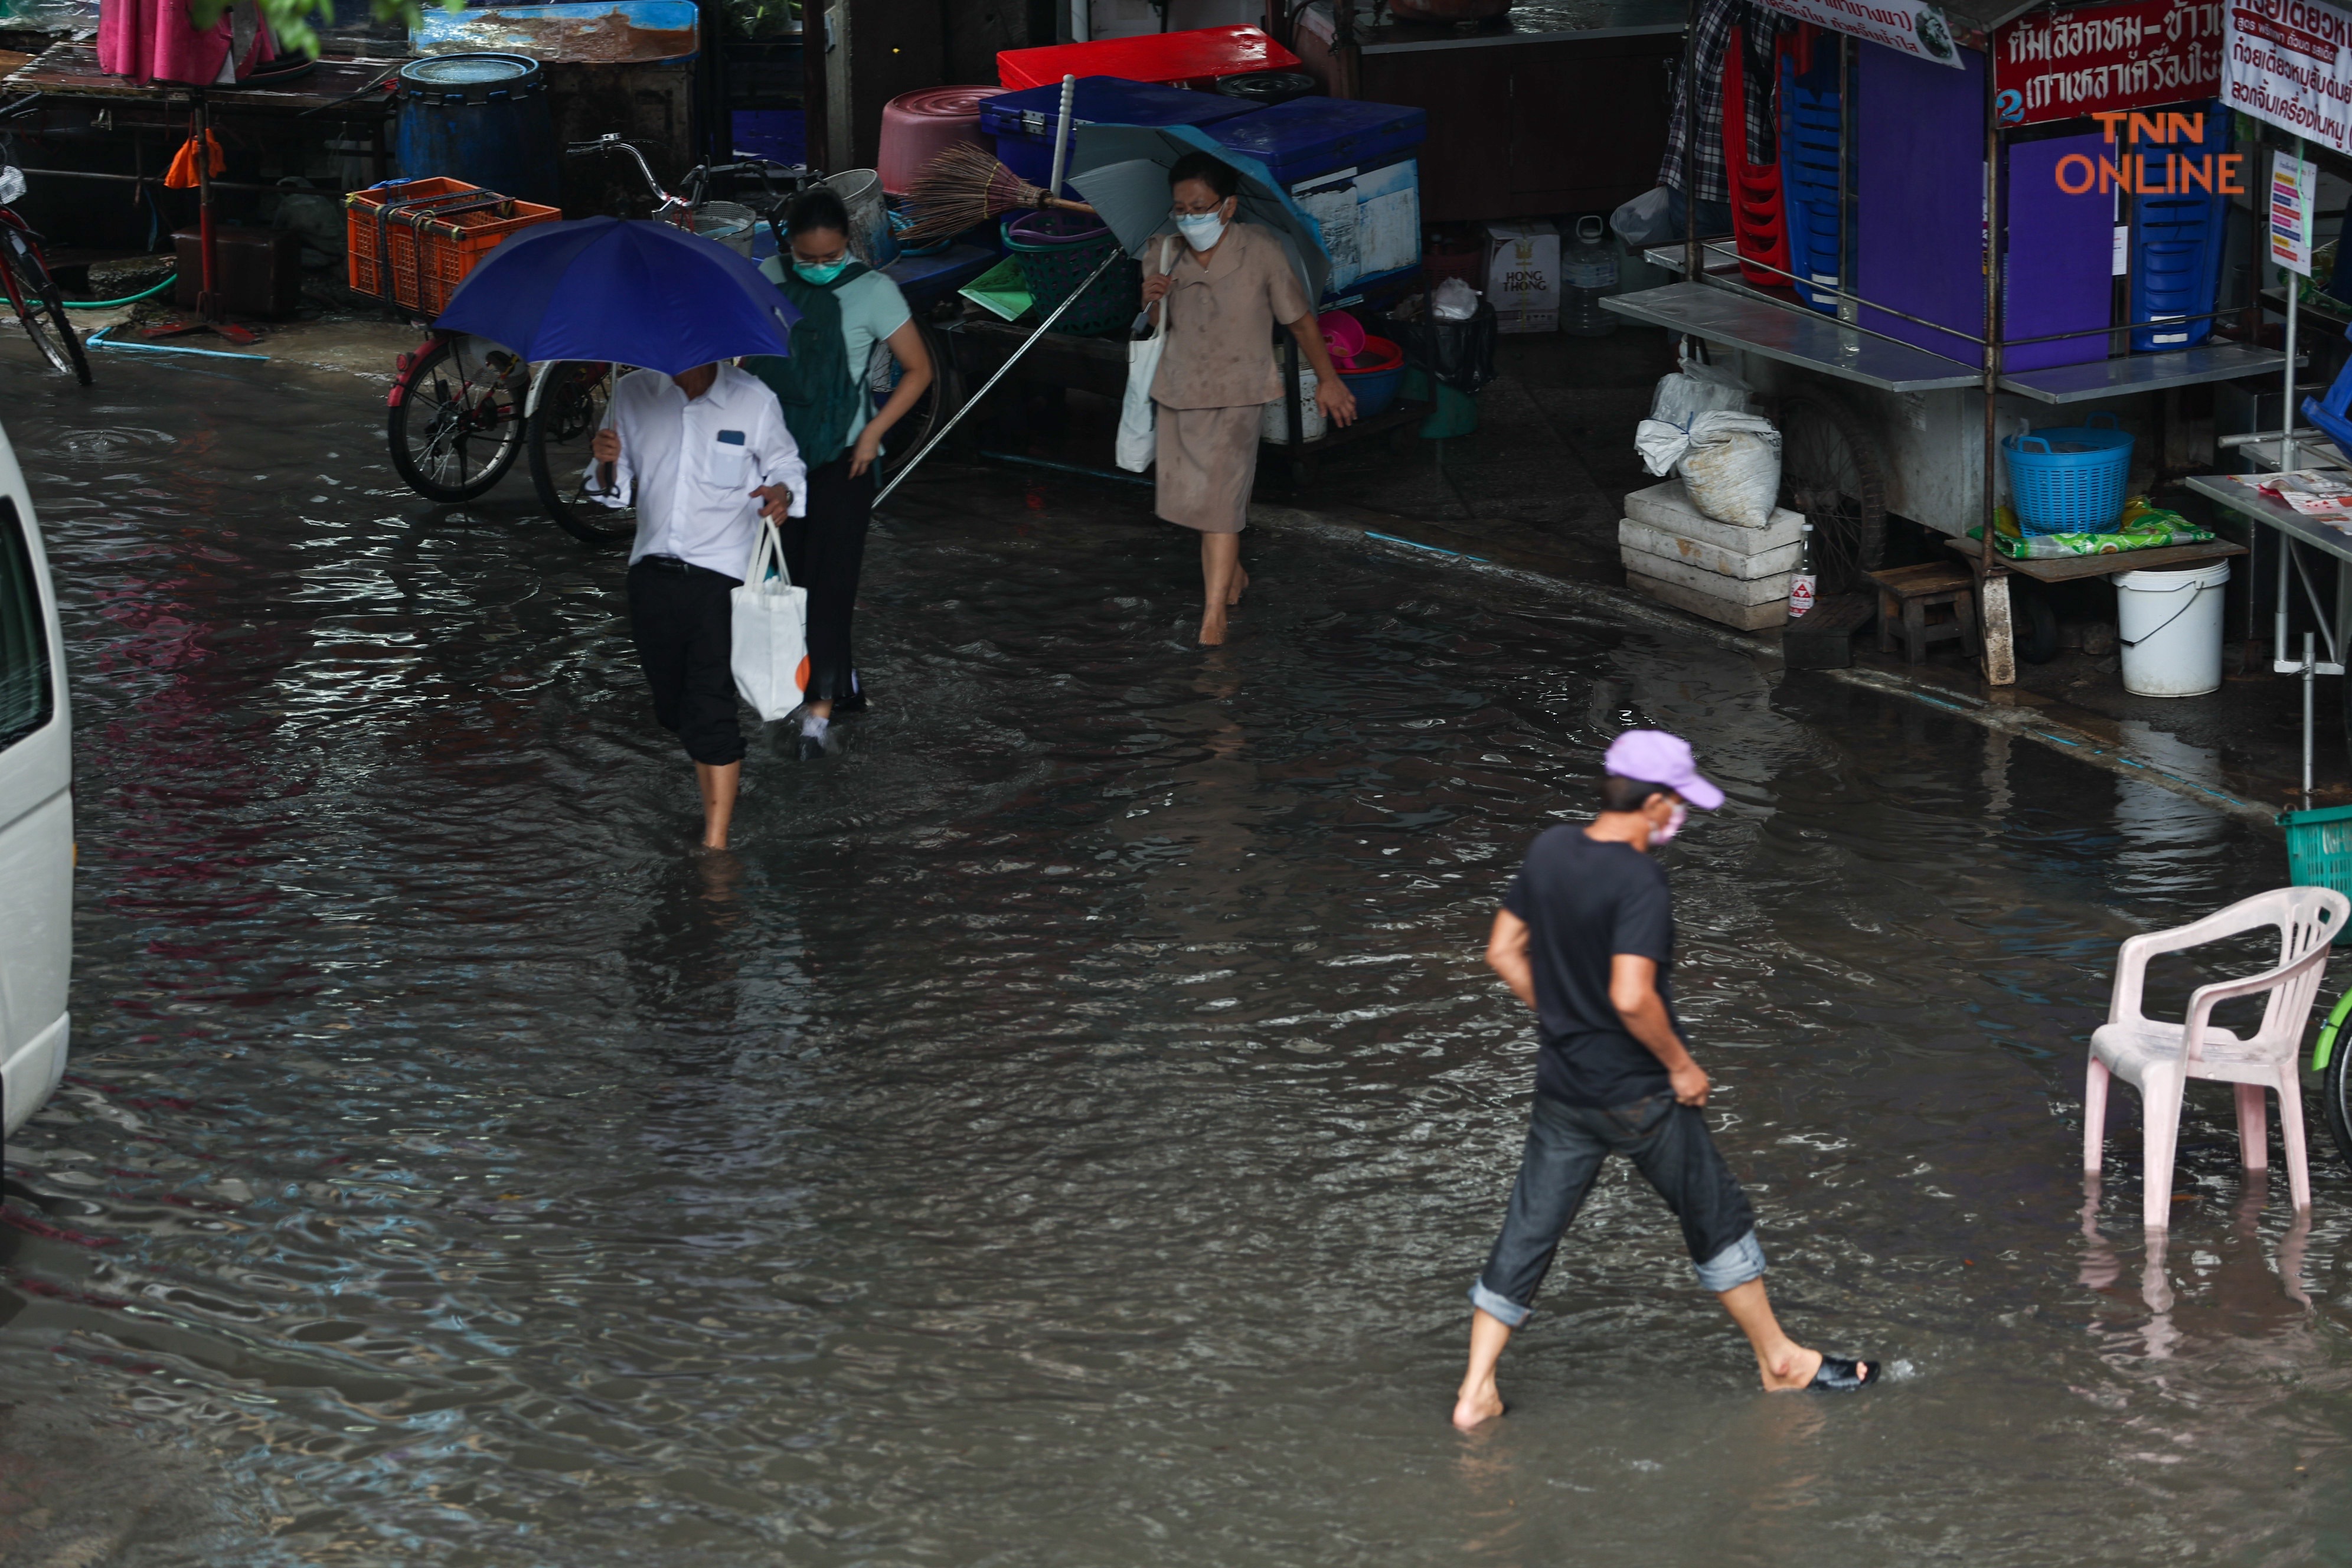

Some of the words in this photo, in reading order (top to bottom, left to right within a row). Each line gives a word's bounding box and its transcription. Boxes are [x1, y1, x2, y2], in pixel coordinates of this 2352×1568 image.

[2237, 17, 2255, 31] สูตร
[2007, 0, 2223, 64] ต้มเลือดหมู-ข้าวเ
[2026, 41, 2222, 109] เกาเหลาเครื่องใน
[1506, 270, 1543, 282] HONG
[1502, 280, 1546, 292] THONG
